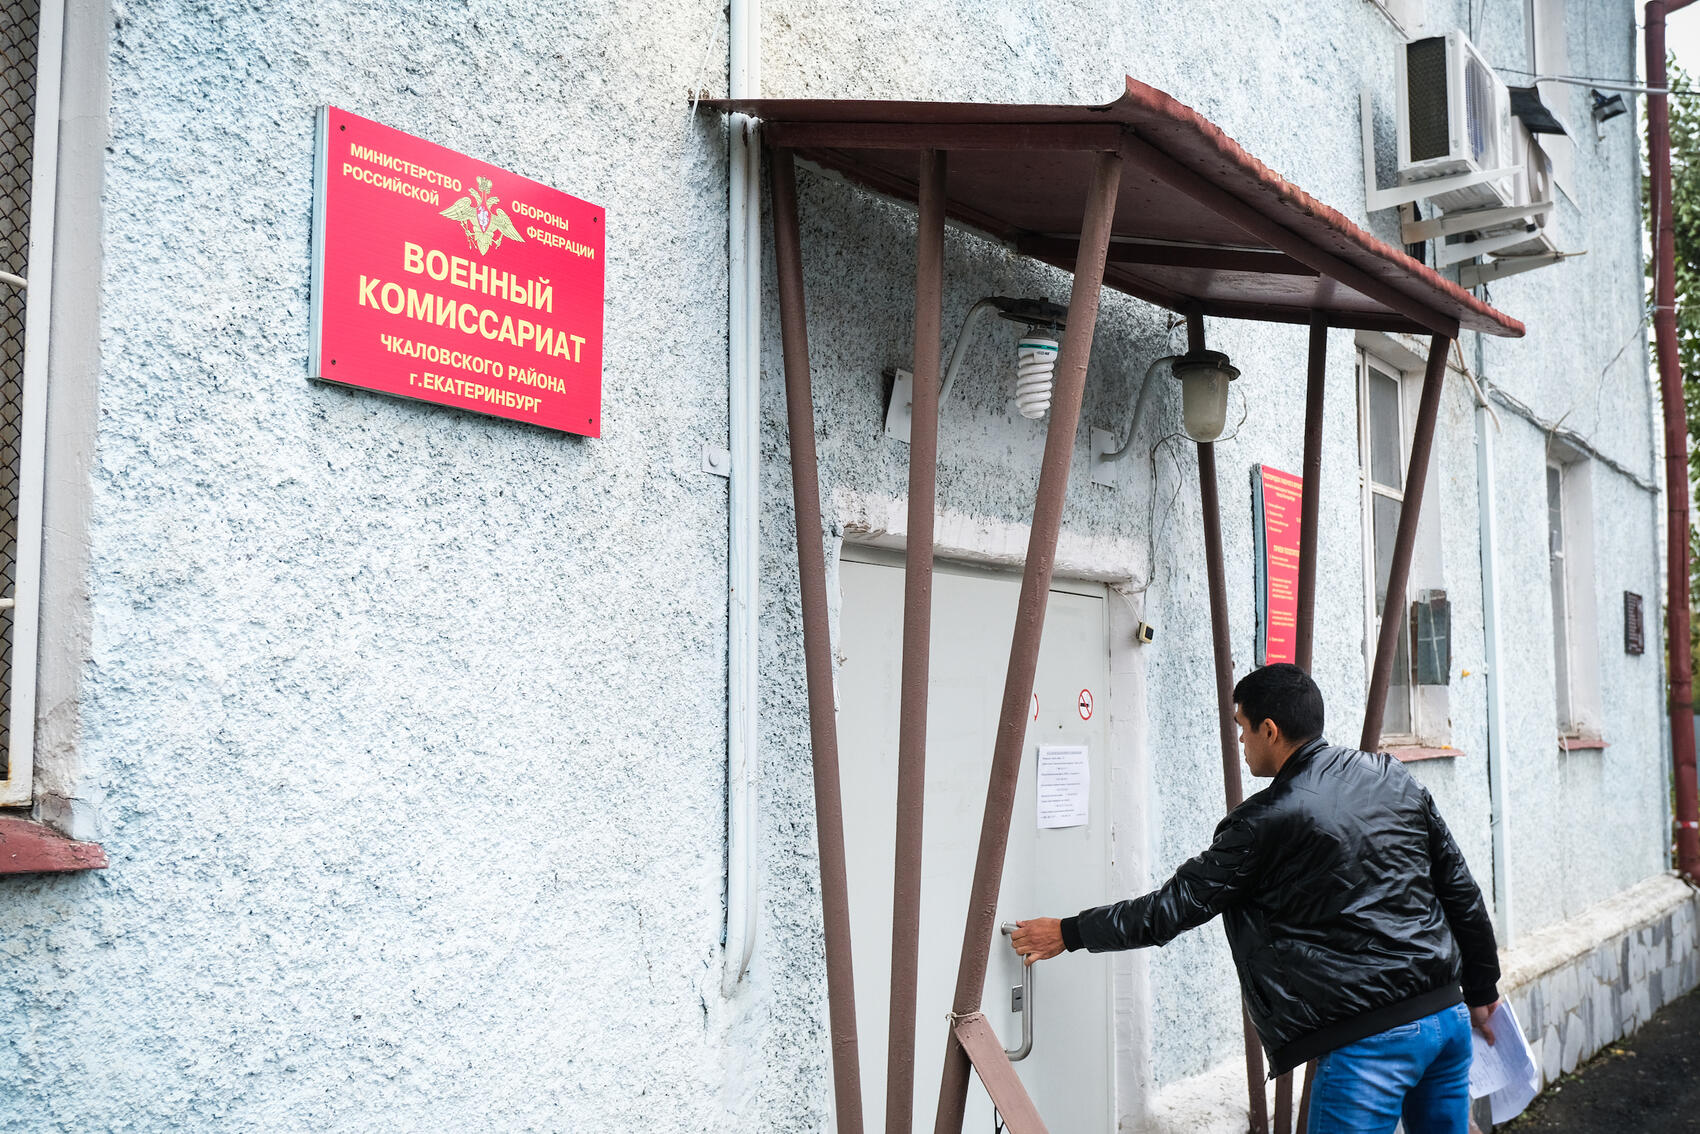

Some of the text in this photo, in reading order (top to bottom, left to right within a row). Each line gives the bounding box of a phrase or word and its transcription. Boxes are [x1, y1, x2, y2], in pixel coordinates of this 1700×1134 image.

[342, 163, 595, 260] РОССИЙСКОЙ ФЕДЕРАЦИИ
[350, 143, 569, 231] МИНИСТЕРСТВО ОБОРОНЫ
[403, 241, 553, 314] ВОЕННЫЙ
[358, 275, 586, 363] КОМИССАРИАТ
[380, 333, 566, 394] ЧКАЛОВСКОГО РАЙОНА
[409, 372, 542, 413] г.ЕКАТЕРИНБУРГ
